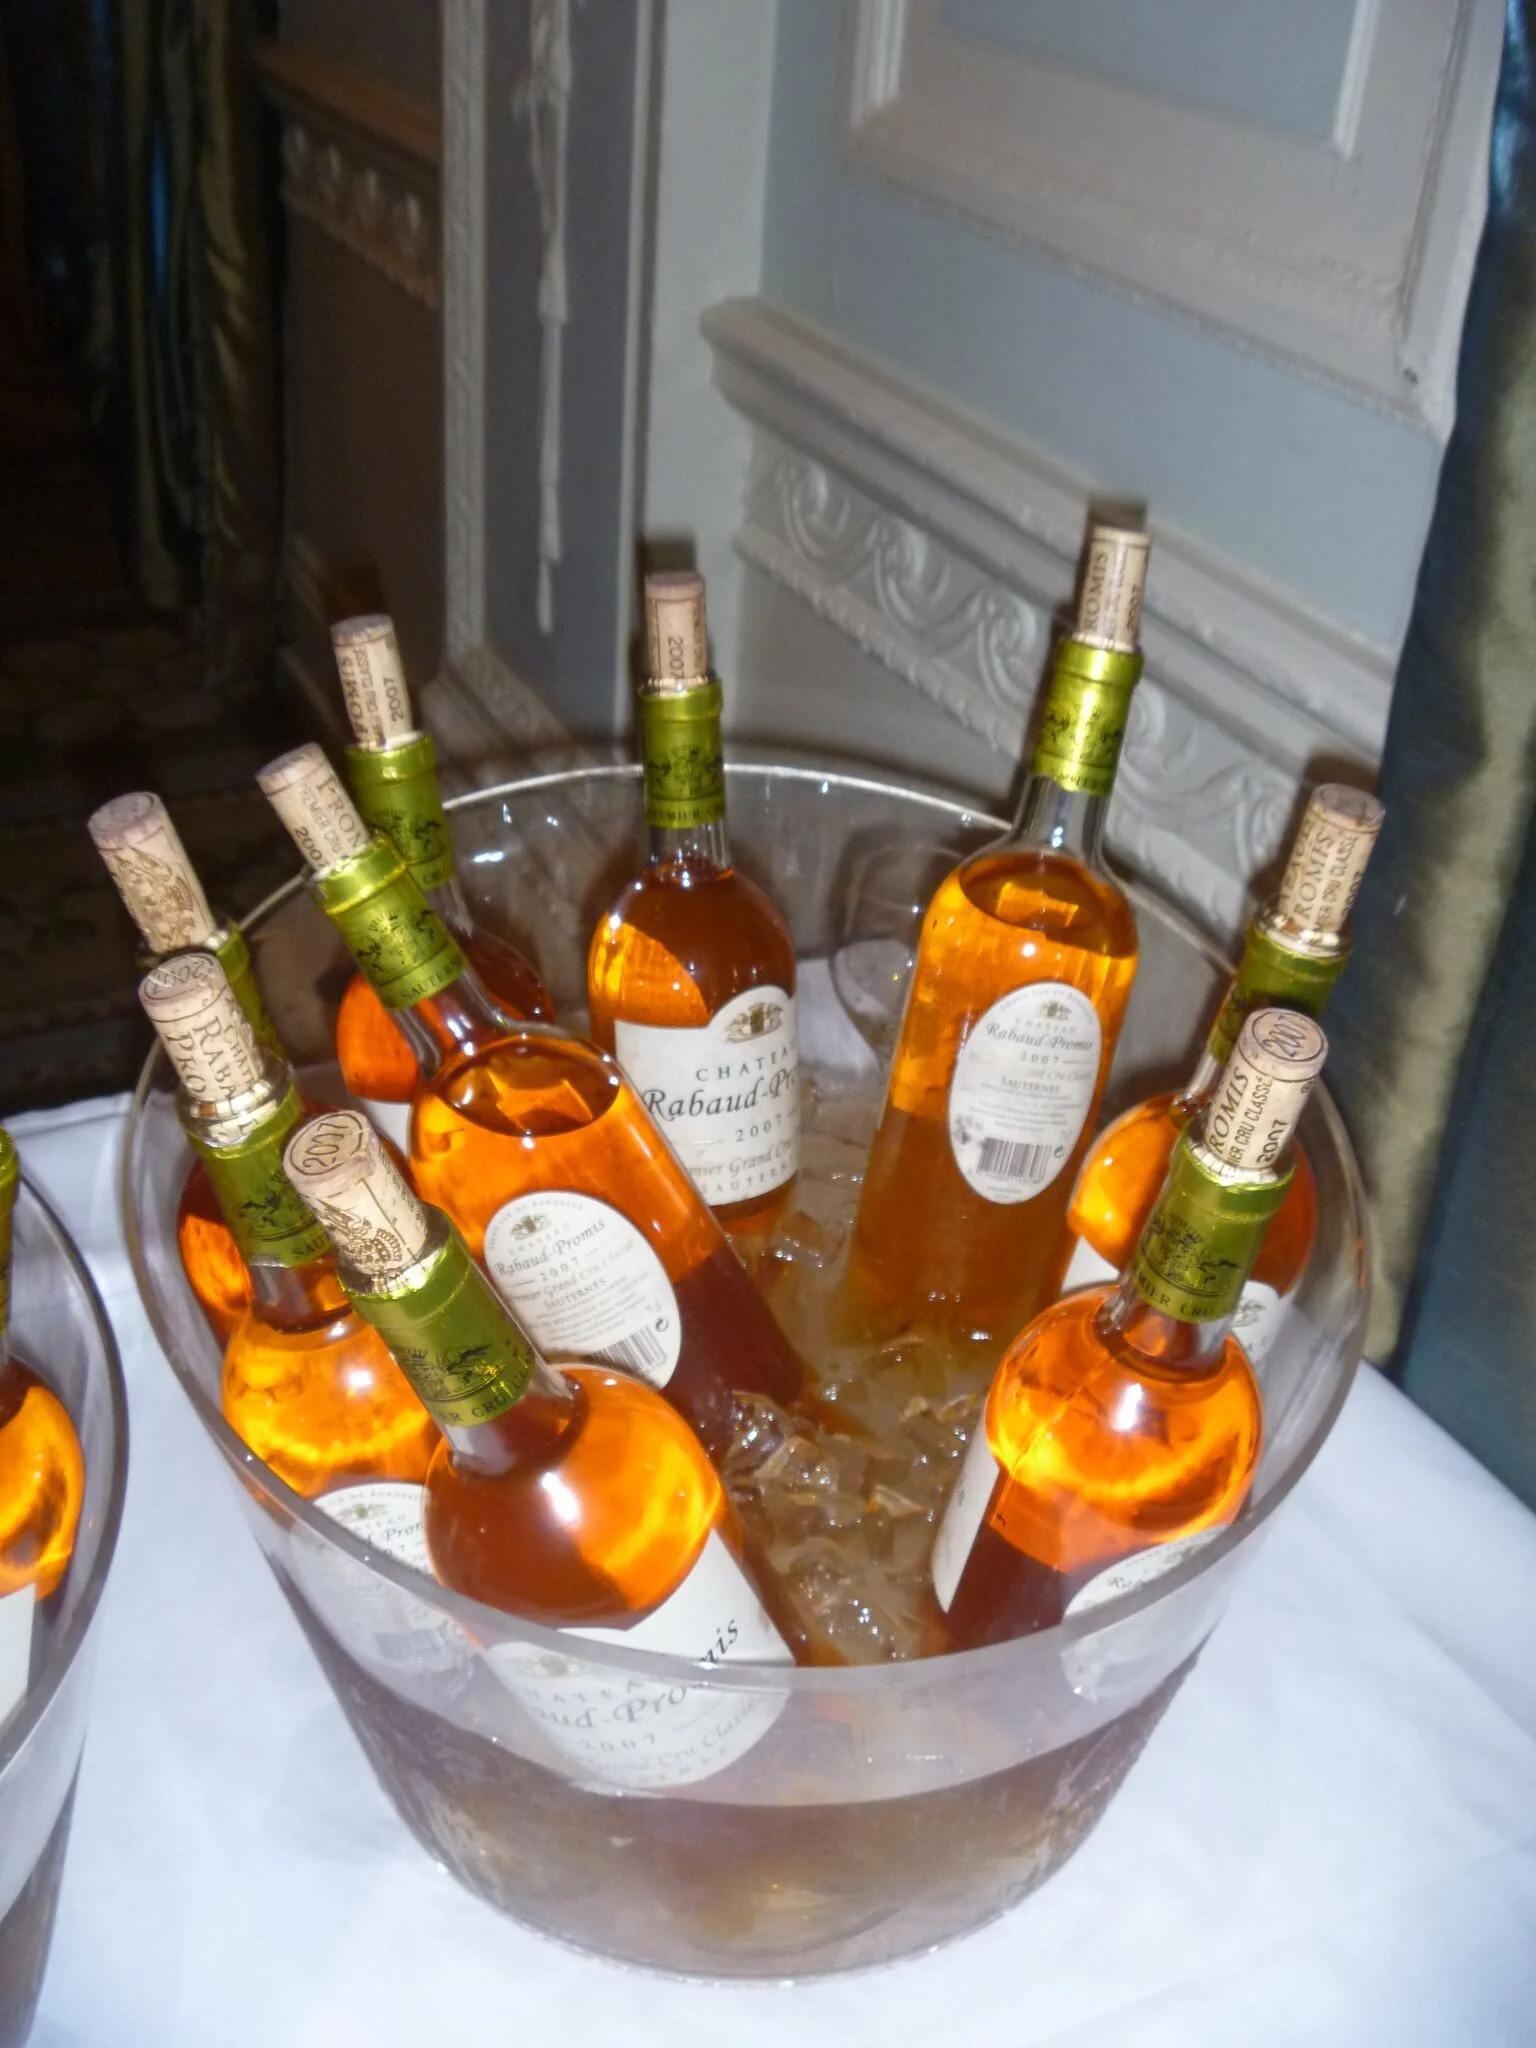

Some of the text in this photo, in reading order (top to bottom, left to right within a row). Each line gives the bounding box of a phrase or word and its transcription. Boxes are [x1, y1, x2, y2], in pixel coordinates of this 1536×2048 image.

[1083, 552, 1109, 633] ROMIS
[668, 636, 685, 679] 2007
[382, 676, 404, 723] 2007
[294, 826, 330, 868] 2007
[1262, 1014, 1310, 1058] 2007
[1018, 1051, 1061, 1066] 2007
[735, 1114, 783, 1143] 2007
[1209, 1066, 1249, 1155] ROMIS
[1236, 1121, 1257, 1148] CRU
[1249, 1075, 1273, 1122] CLASSÉ
[302, 1122, 350, 1168] 2007
[1256, 1118, 1289, 1166] 2007
[495, 1217, 606, 1277] Rabaud-Promis
[539, 1255, 581, 1283] 2007
[542, 1274, 577, 1297] Grand
[580, 1732, 657, 1752] 2007
